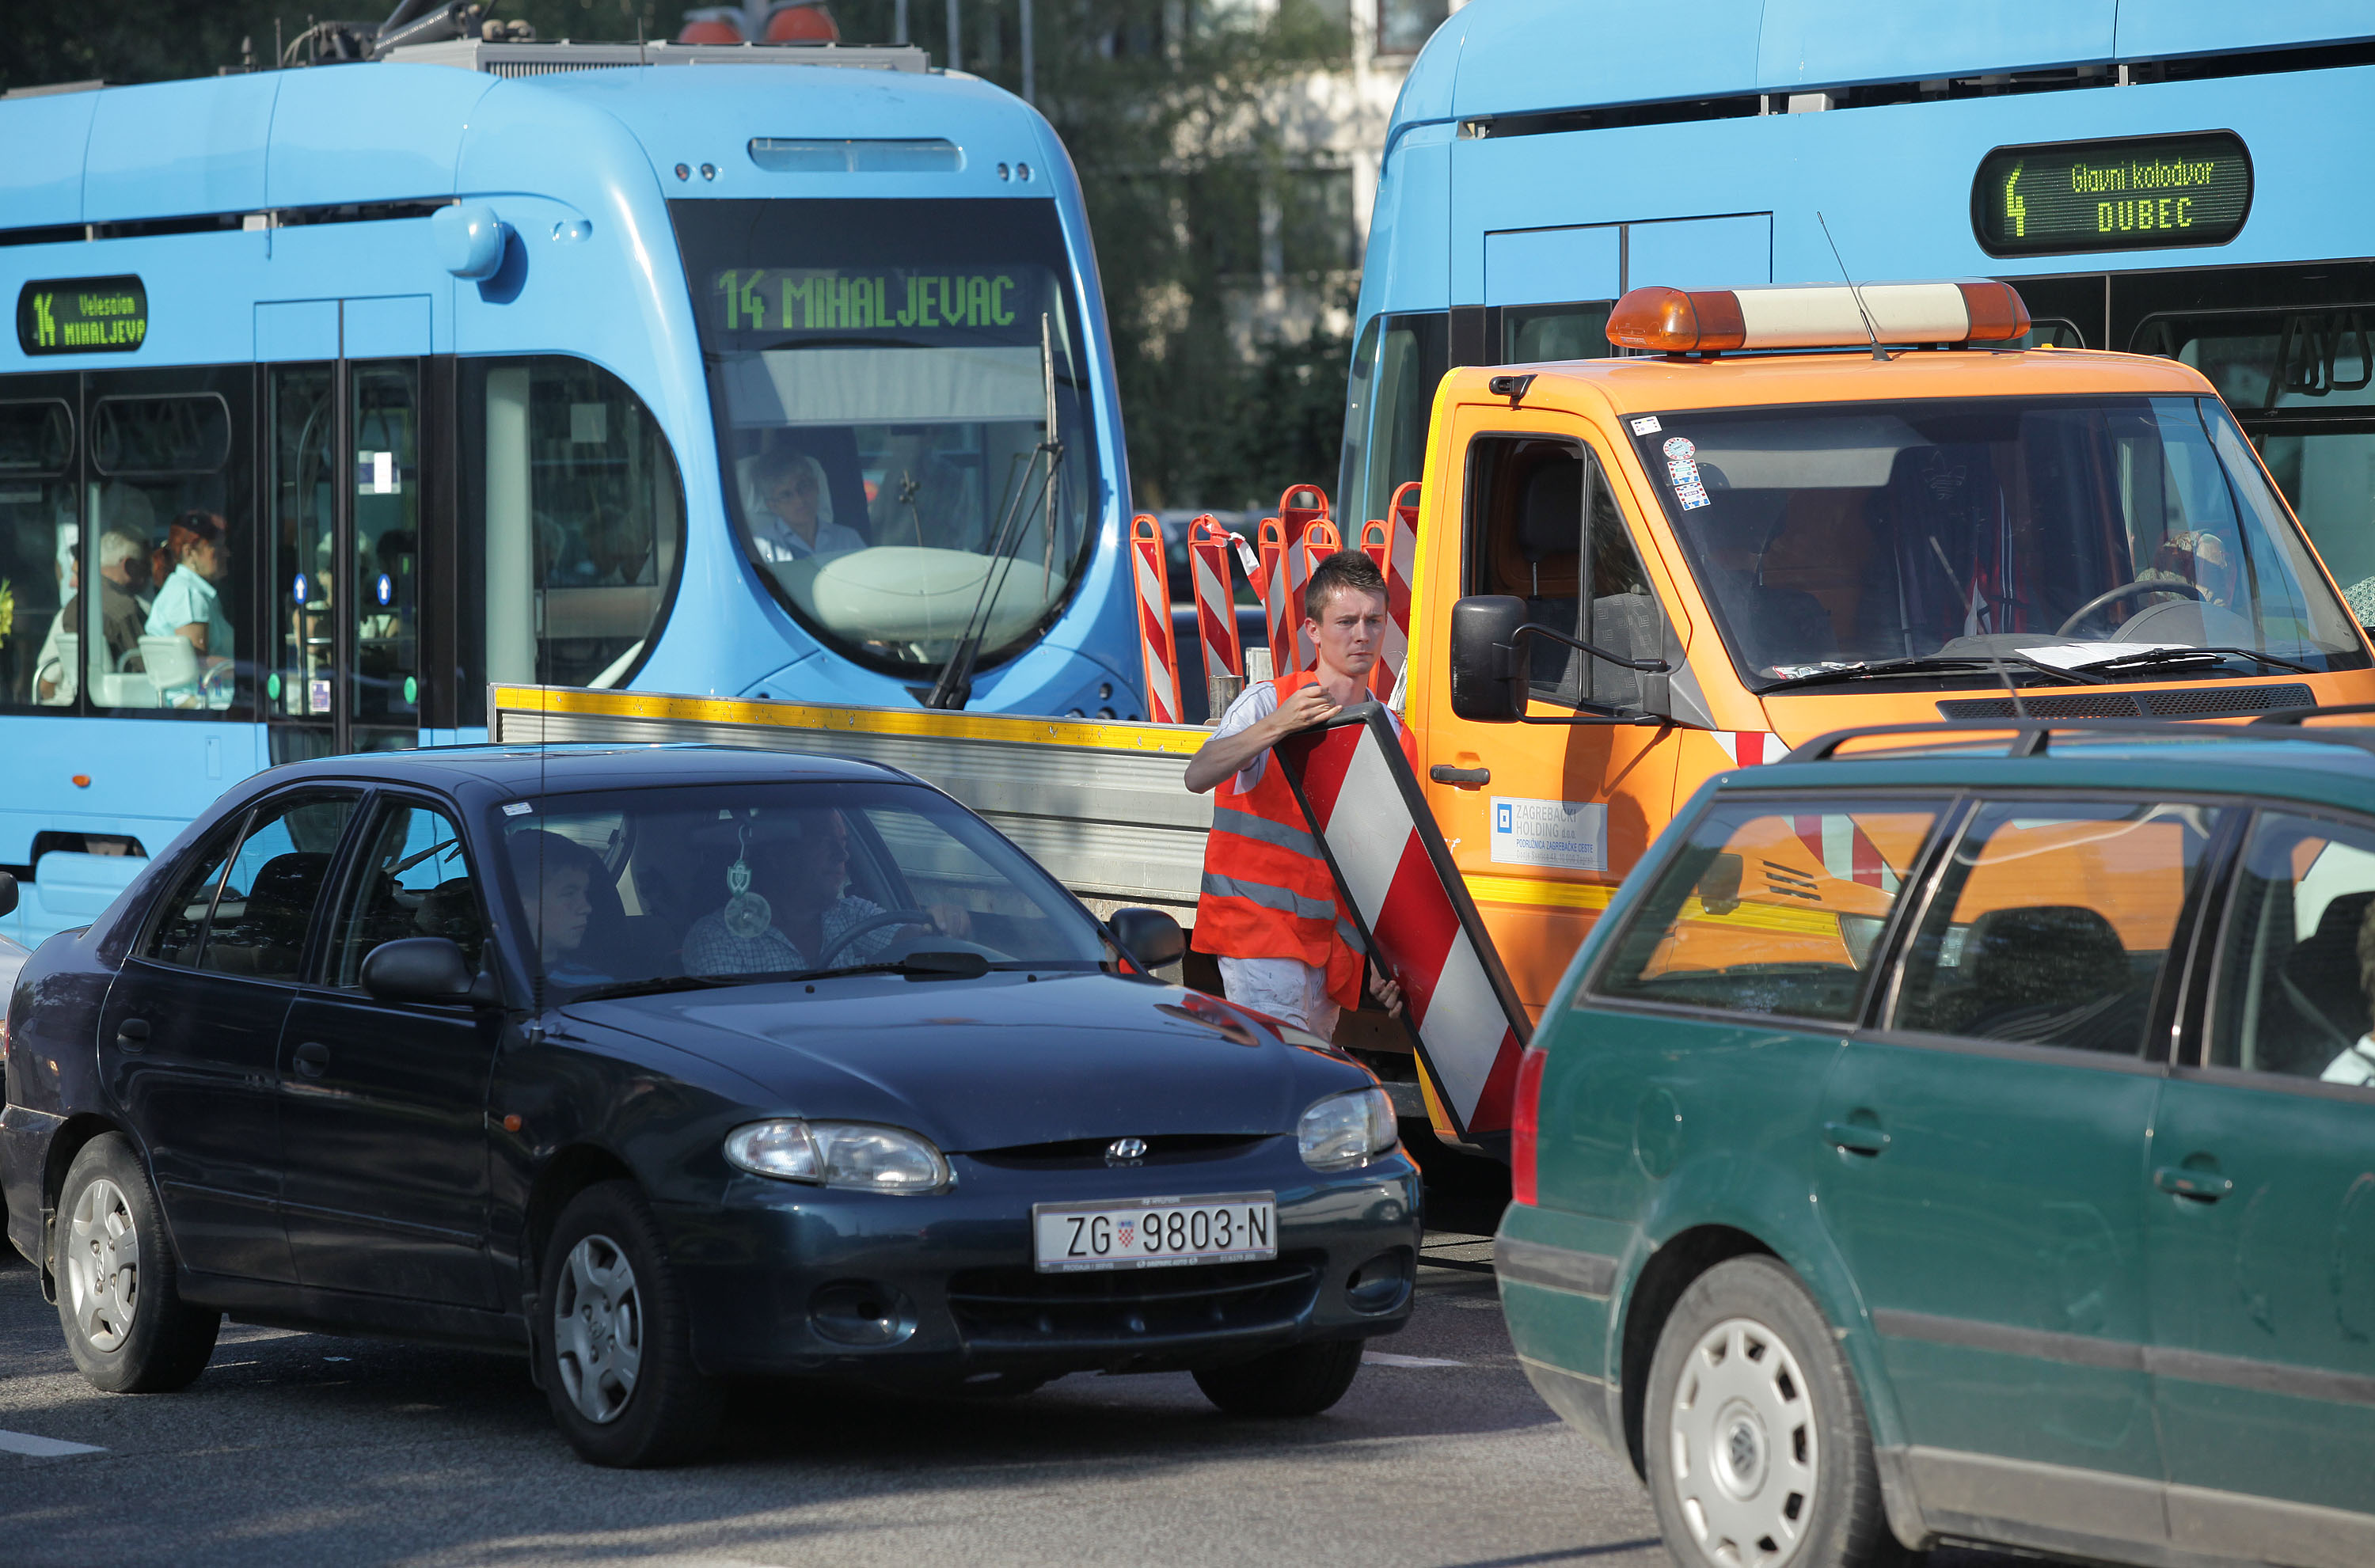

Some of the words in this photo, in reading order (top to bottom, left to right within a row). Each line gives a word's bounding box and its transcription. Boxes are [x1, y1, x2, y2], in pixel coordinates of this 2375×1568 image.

[2071, 160, 2126, 193] Glavni
[2132, 156, 2215, 189] kolodvor
[2005, 159, 2027, 237] 4
[2097, 197, 2193, 233] DUBEC
[33, 292, 56, 347] 14
[718, 269, 766, 330] 14
[782, 275, 1015, 329] MIHALJEVAC
[1516, 821, 1559, 837] HOLDING
[1516, 837, 1545, 850] PODRUŽNICA
[1546, 841, 1578, 852] ZAGREBAČKE
[1578, 843, 1594, 853] CESTE
[1066, 1215, 1111, 1257] ZG
[1142, 1206, 1267, 1253] 9803-N
